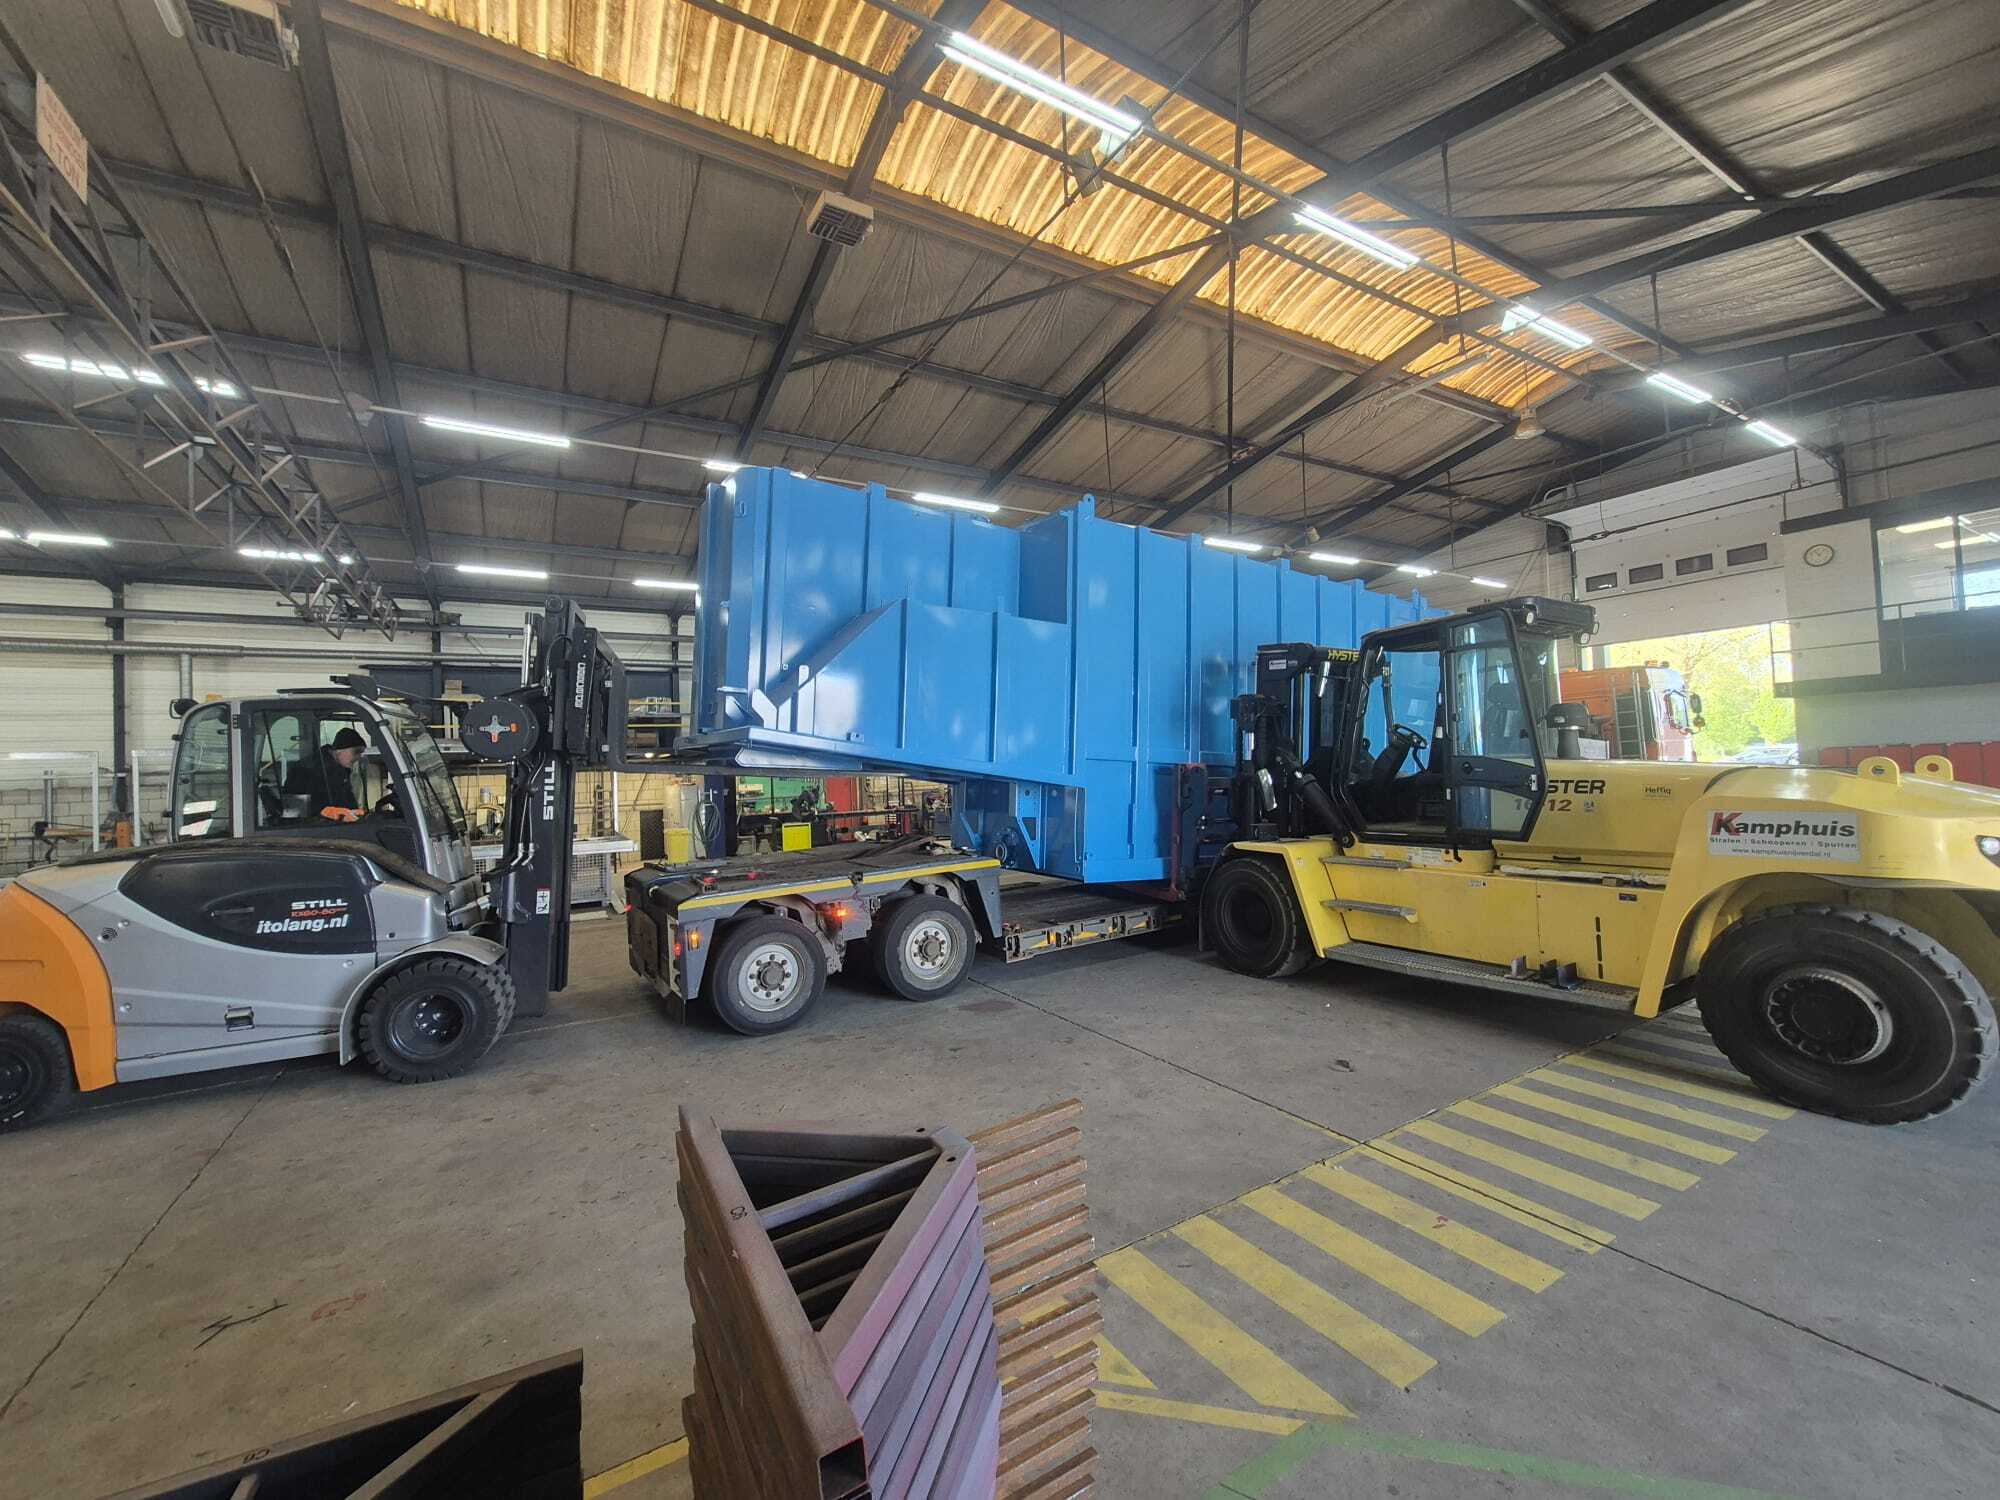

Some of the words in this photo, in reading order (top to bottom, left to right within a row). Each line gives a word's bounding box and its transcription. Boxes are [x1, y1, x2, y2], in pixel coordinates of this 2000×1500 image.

[1328, 649, 1361, 661] HYSTE
[543, 760, 555, 820] STILL
[1547, 779, 1606, 794] STER
[1711, 812, 1856, 838] Kamphuis
[291, 898, 348, 910] STILL
[256, 914, 349, 934] itolang.nl
